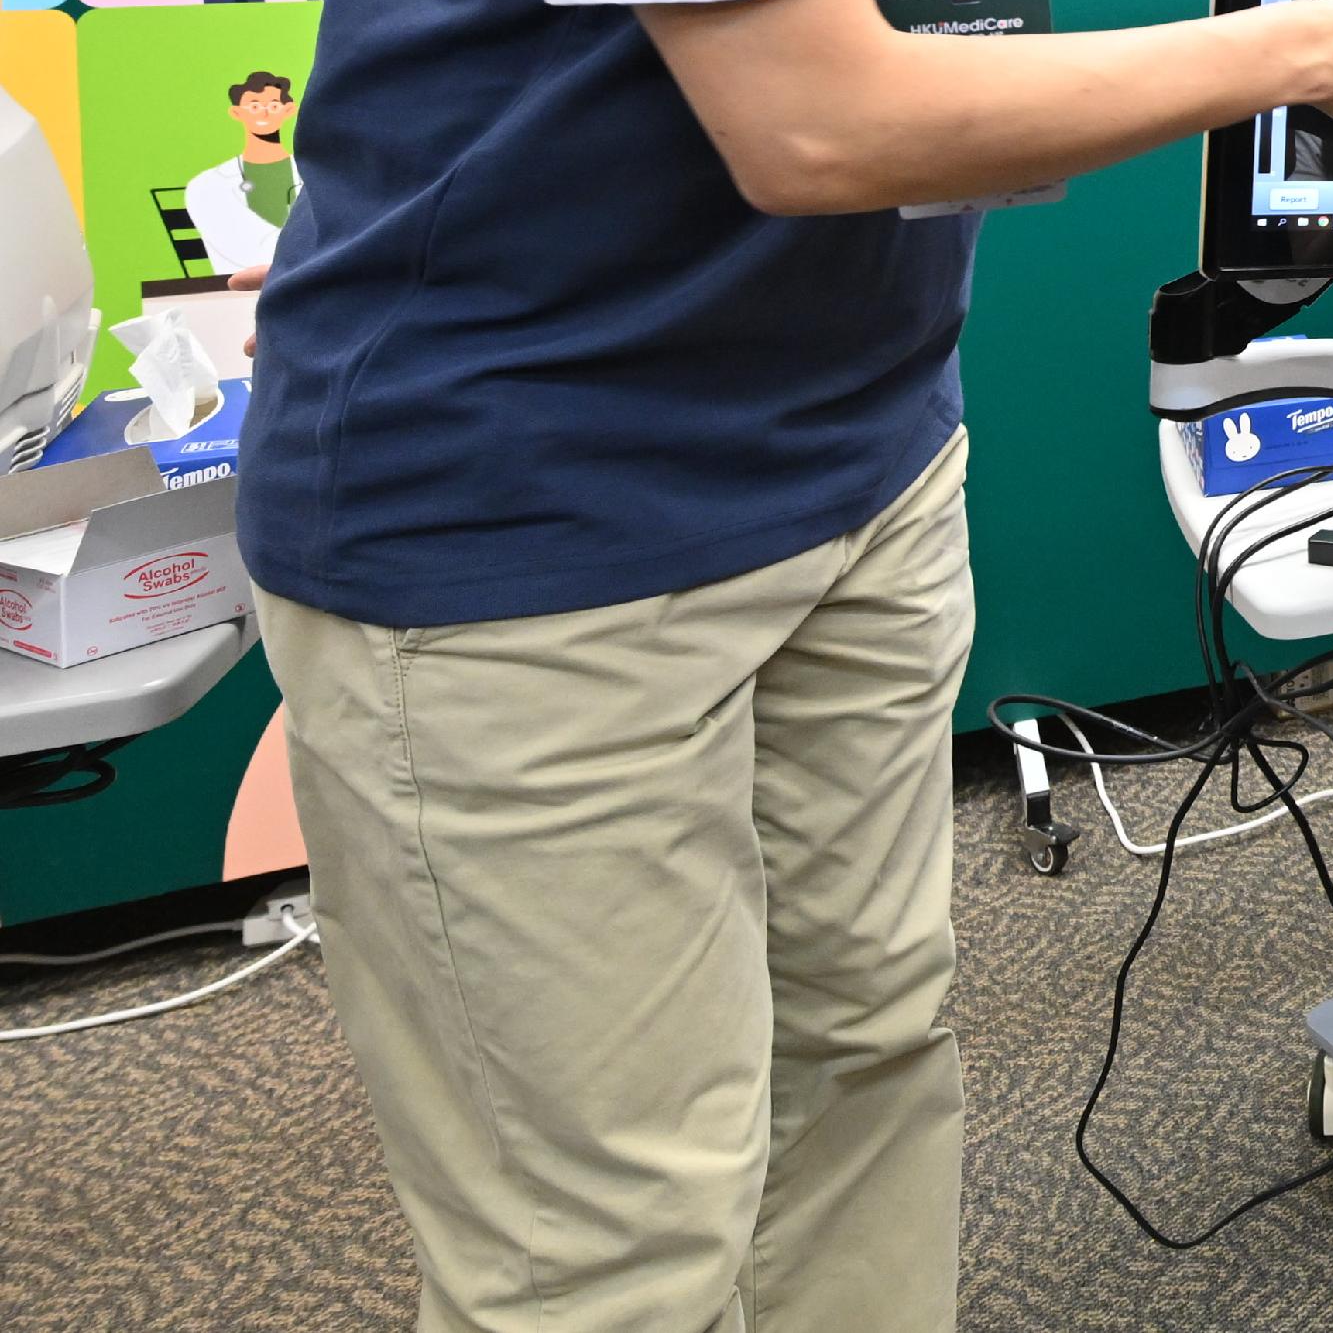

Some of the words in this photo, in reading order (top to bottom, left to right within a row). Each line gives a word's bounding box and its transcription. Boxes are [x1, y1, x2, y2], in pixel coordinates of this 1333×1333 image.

[910, 16, 1024, 35] HKUMediCare
[138, 558, 195, 583] Alcohol
[143, 572, 190, 592] Swabs
